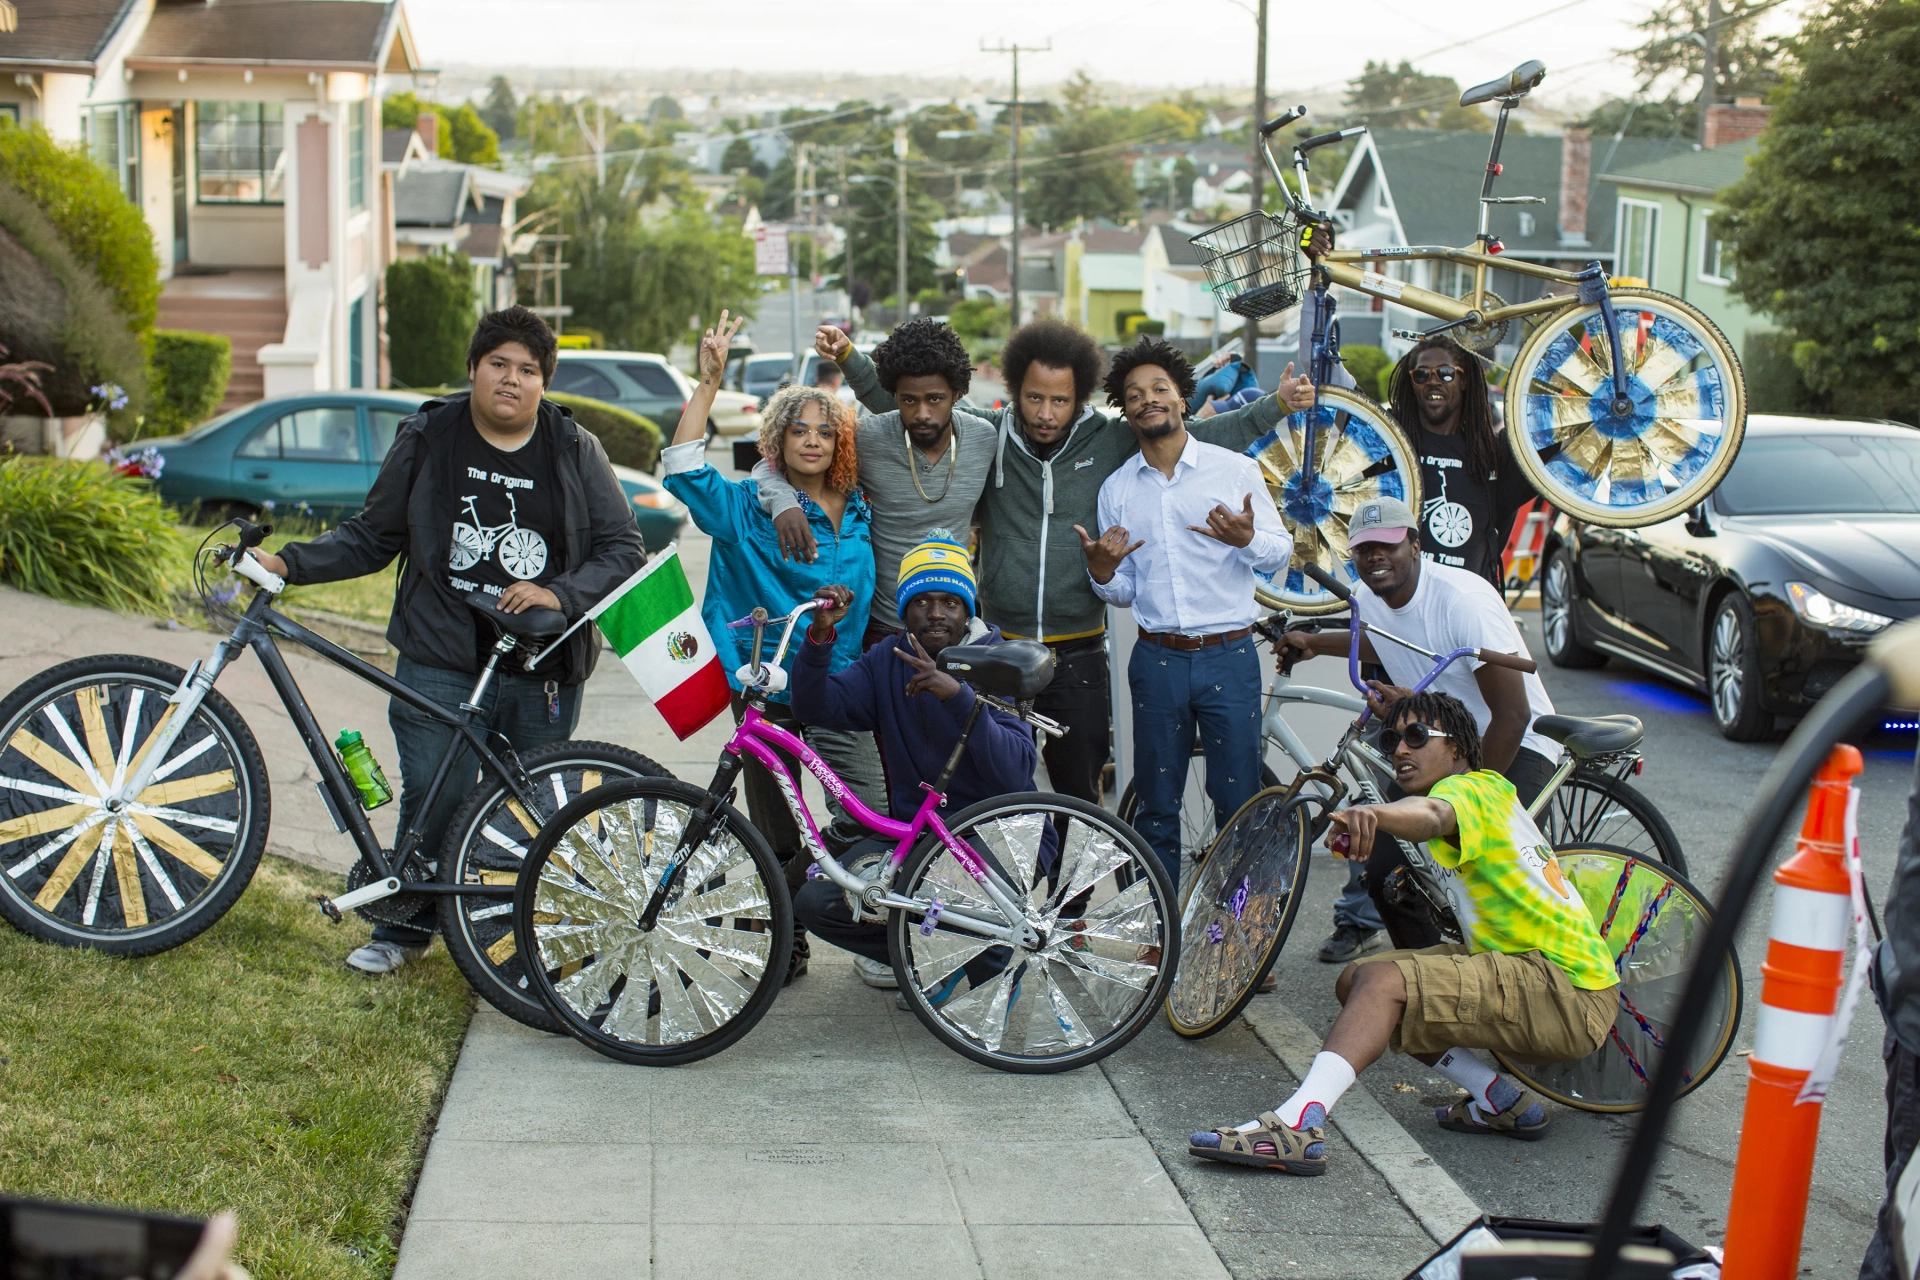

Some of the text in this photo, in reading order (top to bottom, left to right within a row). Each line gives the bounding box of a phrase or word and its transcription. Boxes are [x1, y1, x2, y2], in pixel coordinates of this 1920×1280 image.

[467, 466, 534, 490] The Original
[1438, 552, 1465, 567] Team
[905, 578, 925, 591] FOR
[772, 769, 827, 860] MAGNA
